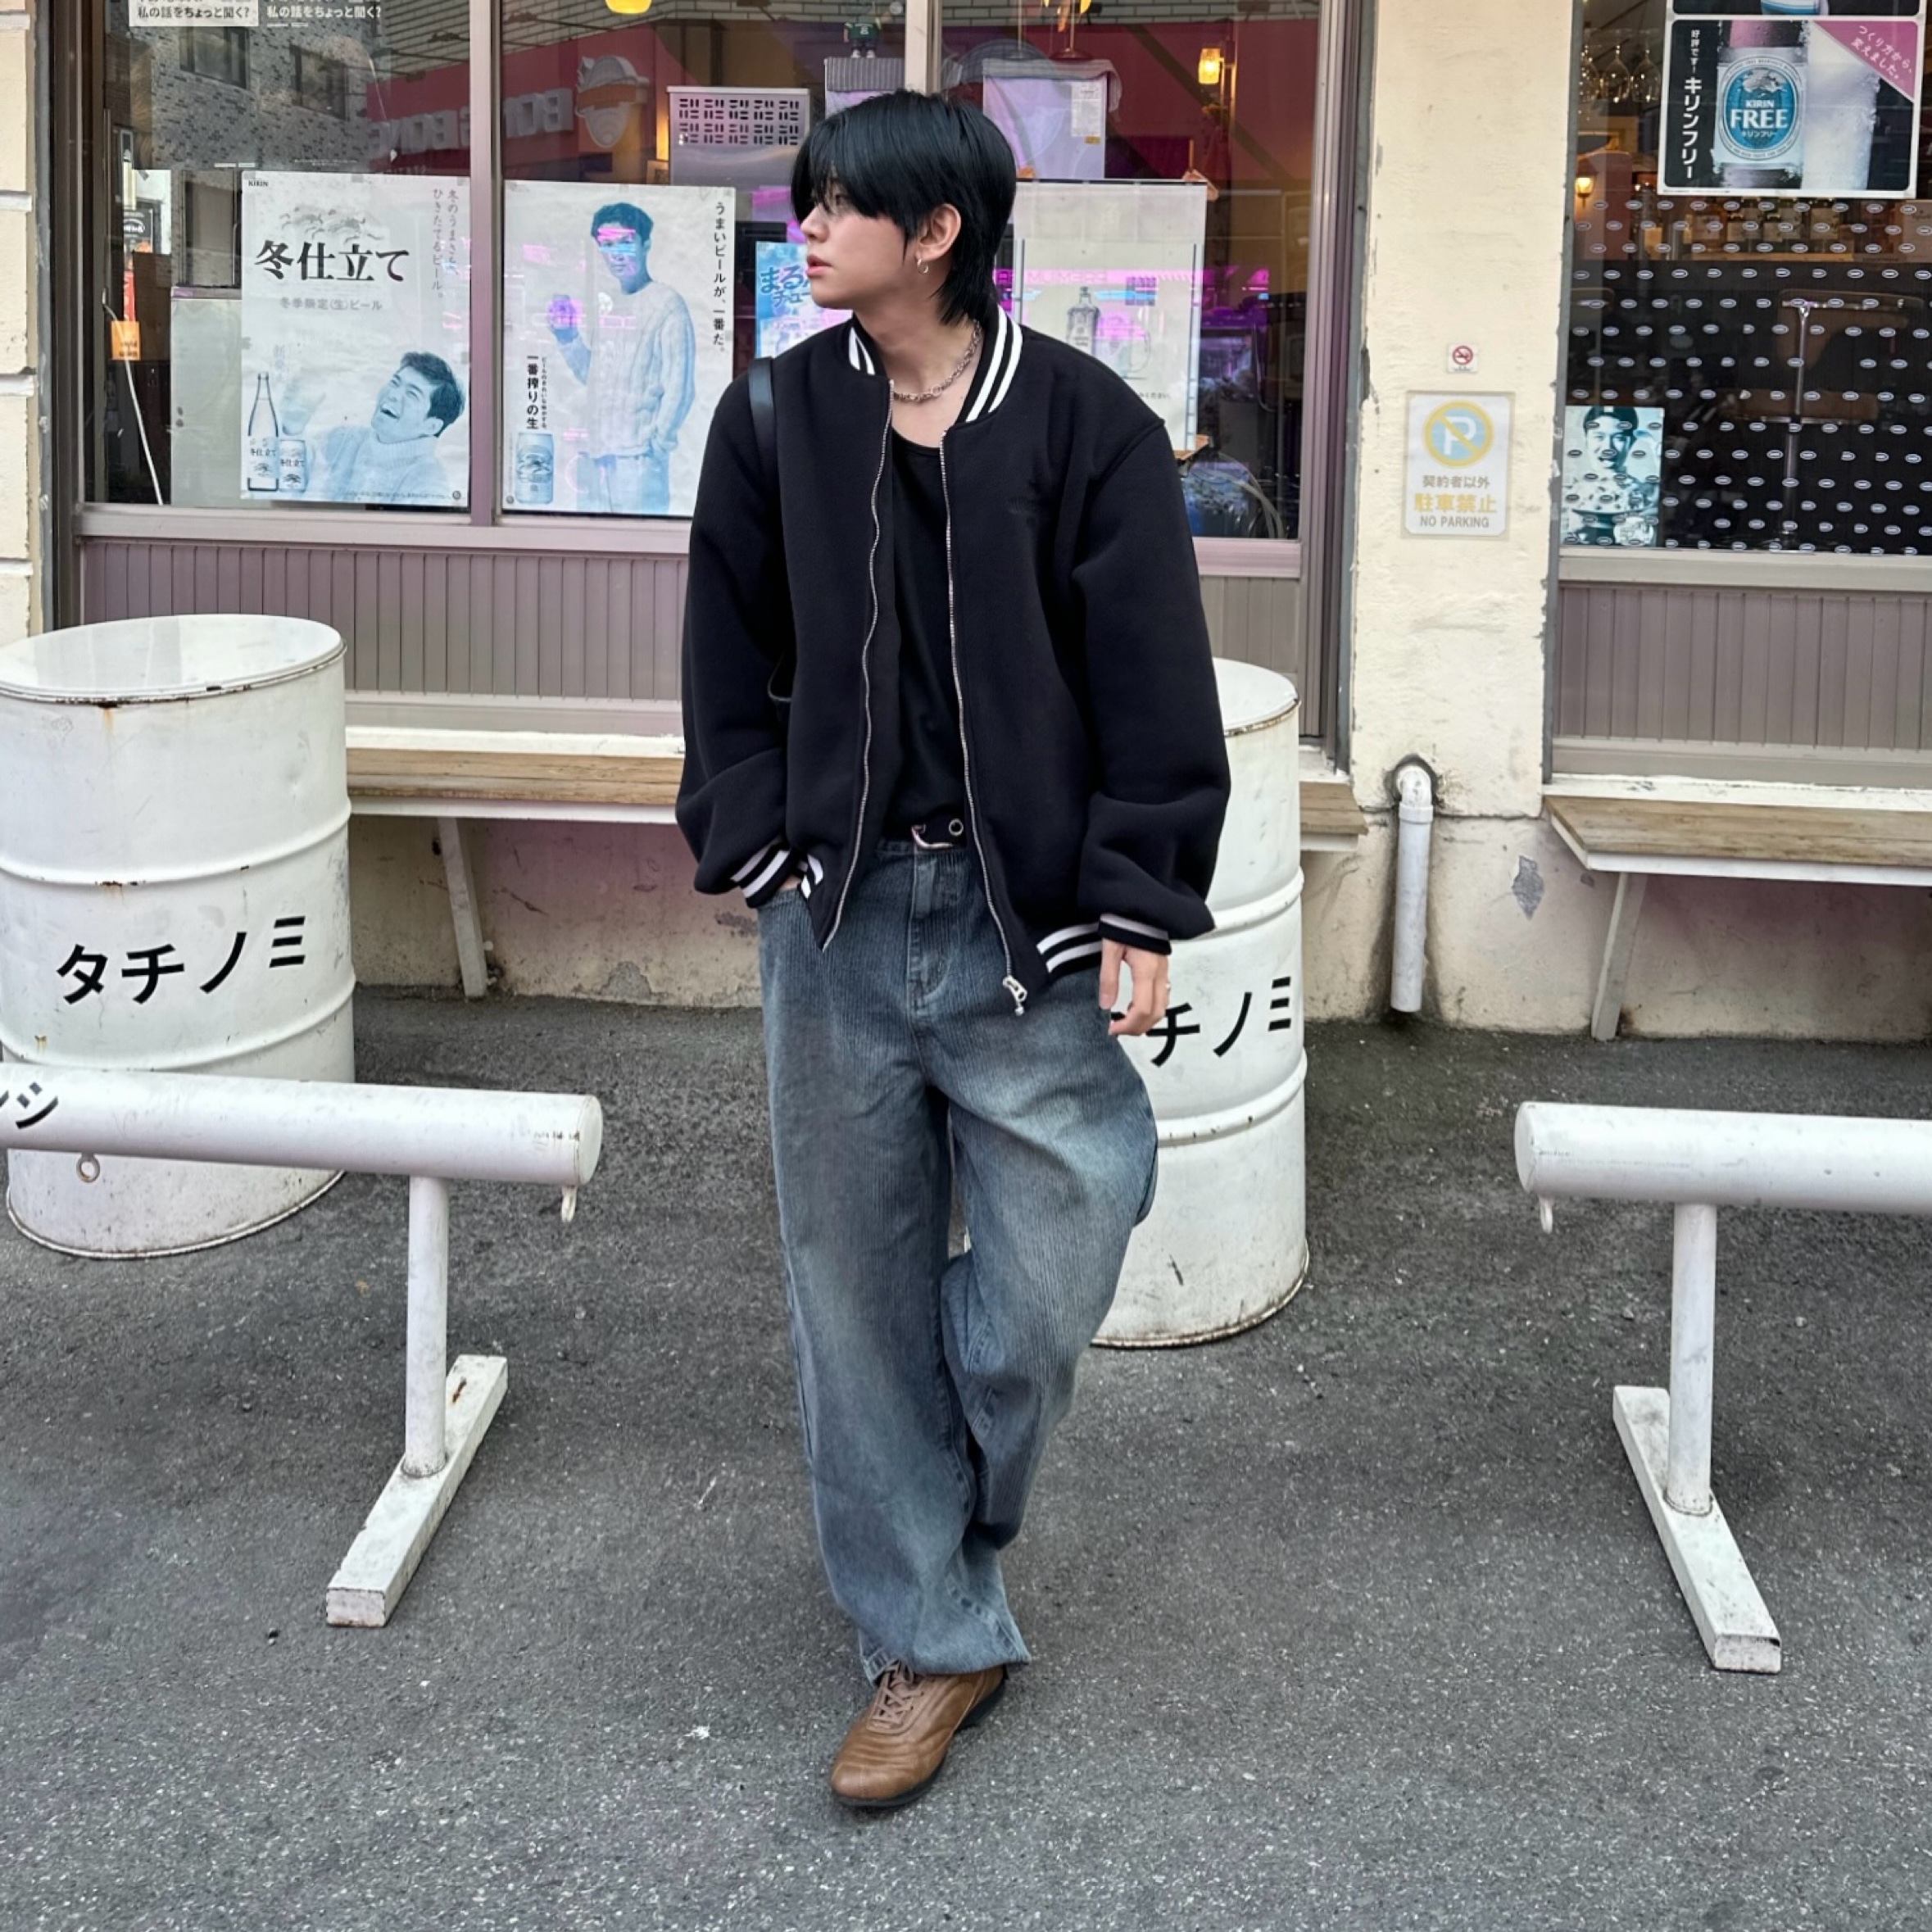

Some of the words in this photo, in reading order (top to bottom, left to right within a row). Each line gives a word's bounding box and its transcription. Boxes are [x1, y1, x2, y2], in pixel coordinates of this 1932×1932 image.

[1730, 108, 1788, 129] FREE
[1745, 99, 1775, 108] KIRIN
[1682, 77, 1702, 179] キリンフリー
[254, 240, 410, 282] 冬仕立て
[713, 202, 726, 352] うまいビールが、一番だ。
[527, 356, 539, 430] 一番搾りの生
[1415, 493, 1496, 513] 駐車禁止
[1422, 475, 1490, 489] 契約者以外
[1420, 515, 1436, 527] NO
[1440, 516, 1490, 528] PARKING
[56, 915, 306, 1005] タチノミ
[1110, 976, 1291, 1067] チノミ
